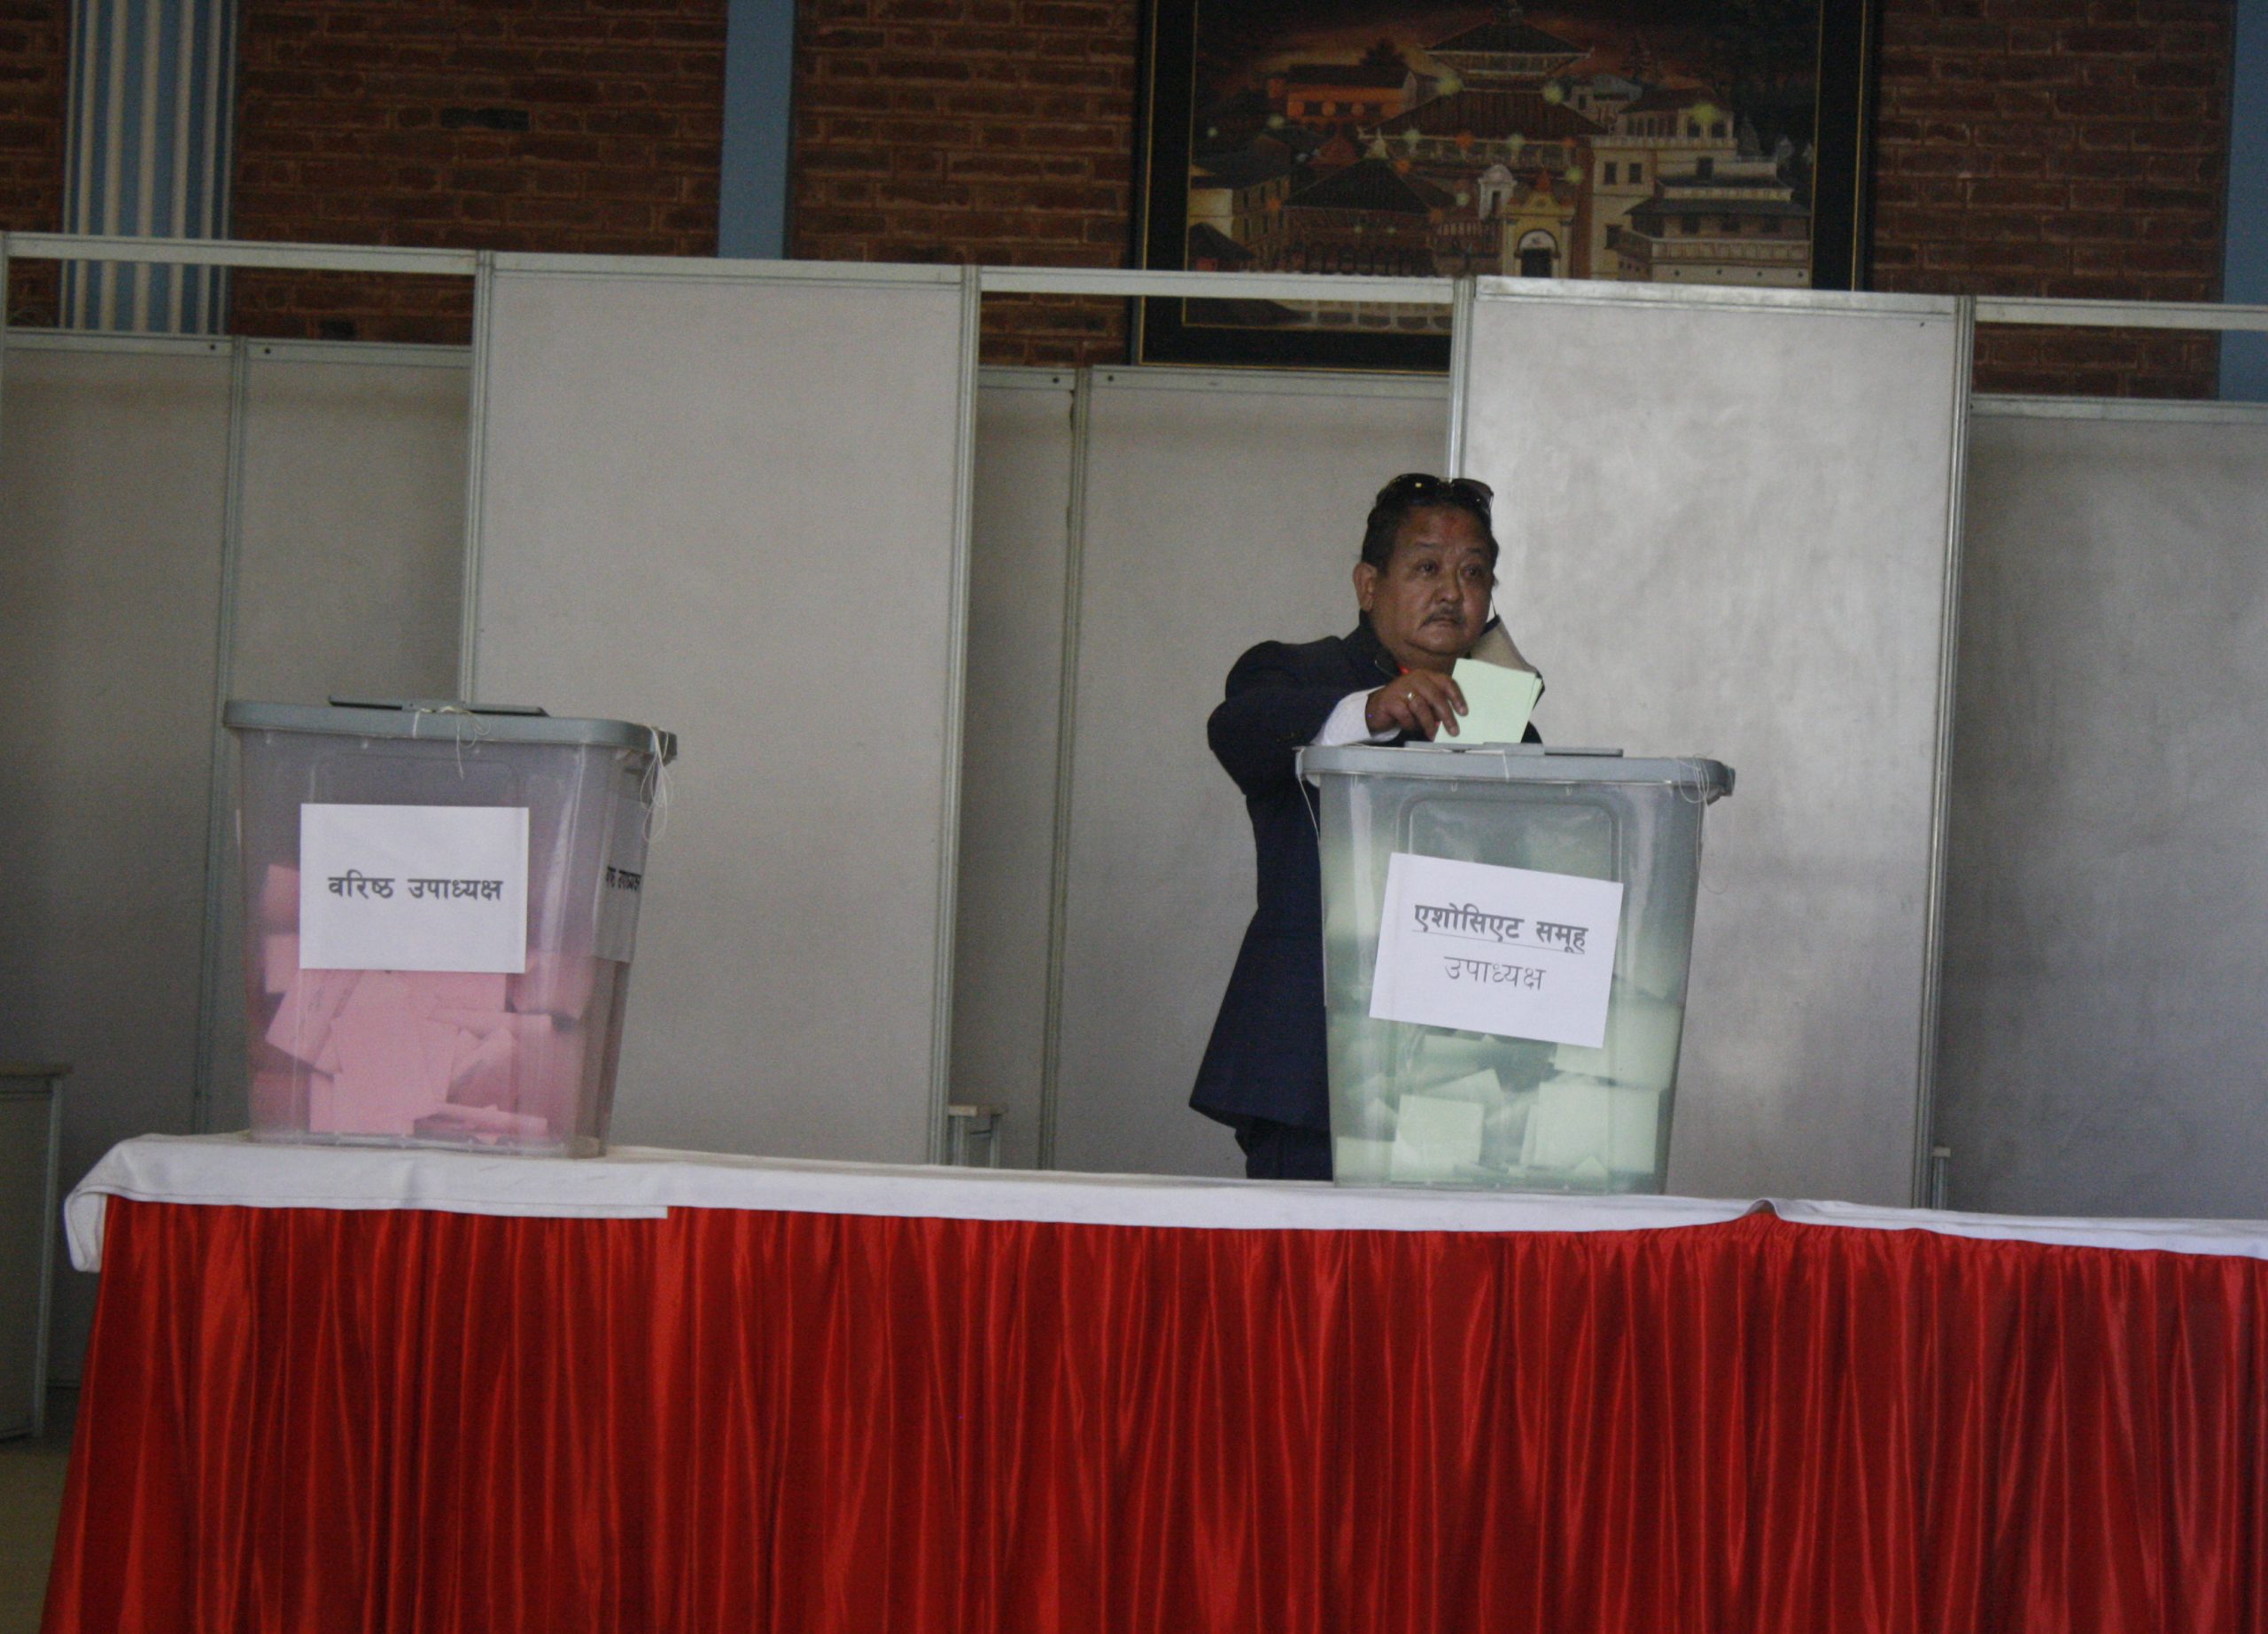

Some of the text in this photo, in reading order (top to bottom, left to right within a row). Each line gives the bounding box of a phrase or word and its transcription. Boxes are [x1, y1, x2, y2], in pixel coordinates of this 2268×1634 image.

[328, 869, 503, 900] वरिष्ठ उपाध्यक्ष
[1415, 902, 1589, 954] एशोसिएट समूह
[1444, 956, 1547, 991] उपाध्यक्ष
